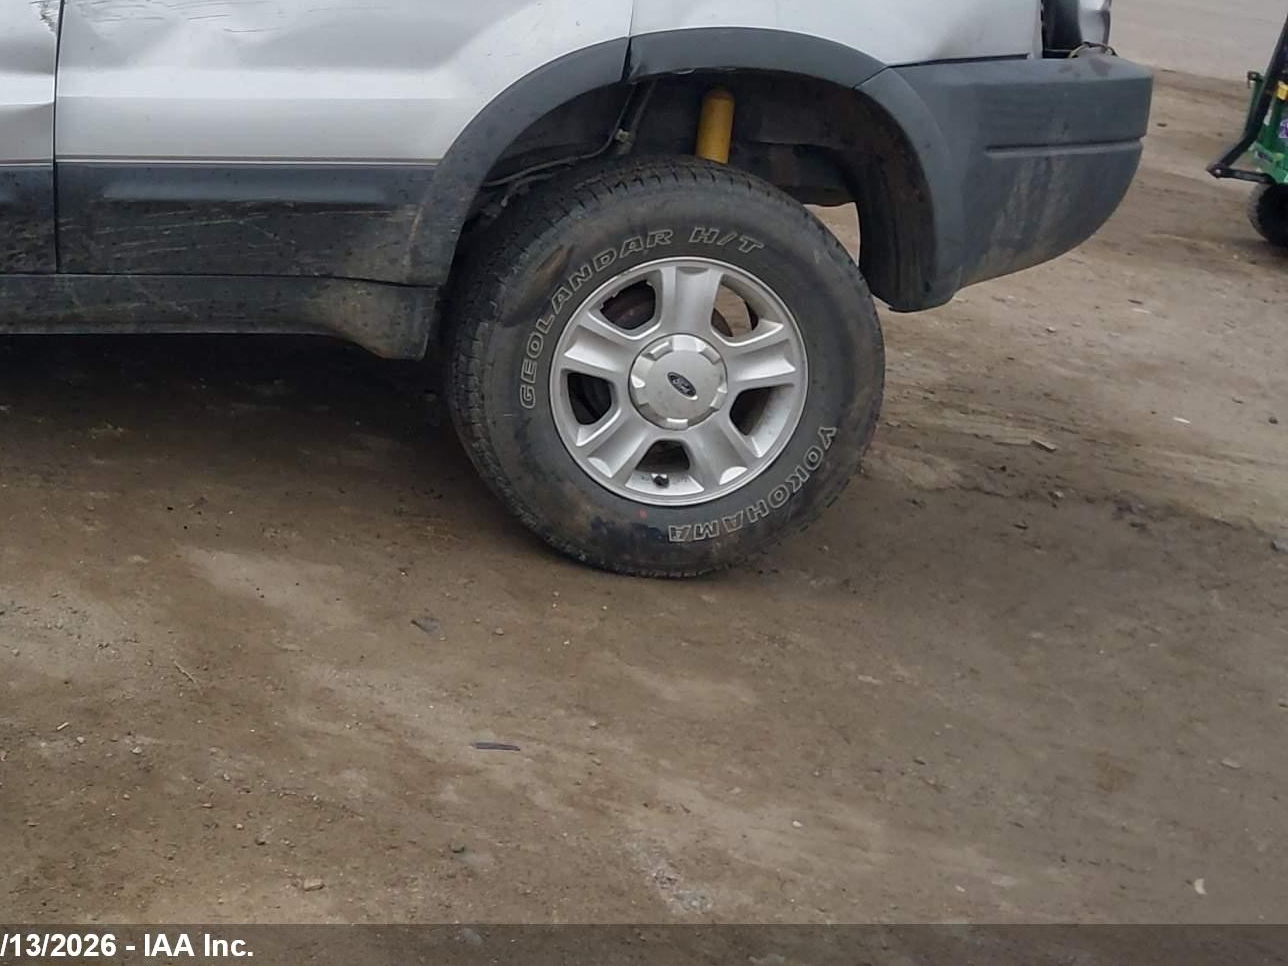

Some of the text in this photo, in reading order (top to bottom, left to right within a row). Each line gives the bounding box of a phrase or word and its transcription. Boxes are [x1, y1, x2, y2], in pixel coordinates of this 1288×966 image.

[519, 225, 765, 409] GEOLANDAR H/T
[668, 426, 838, 542] YOKOHAMA
